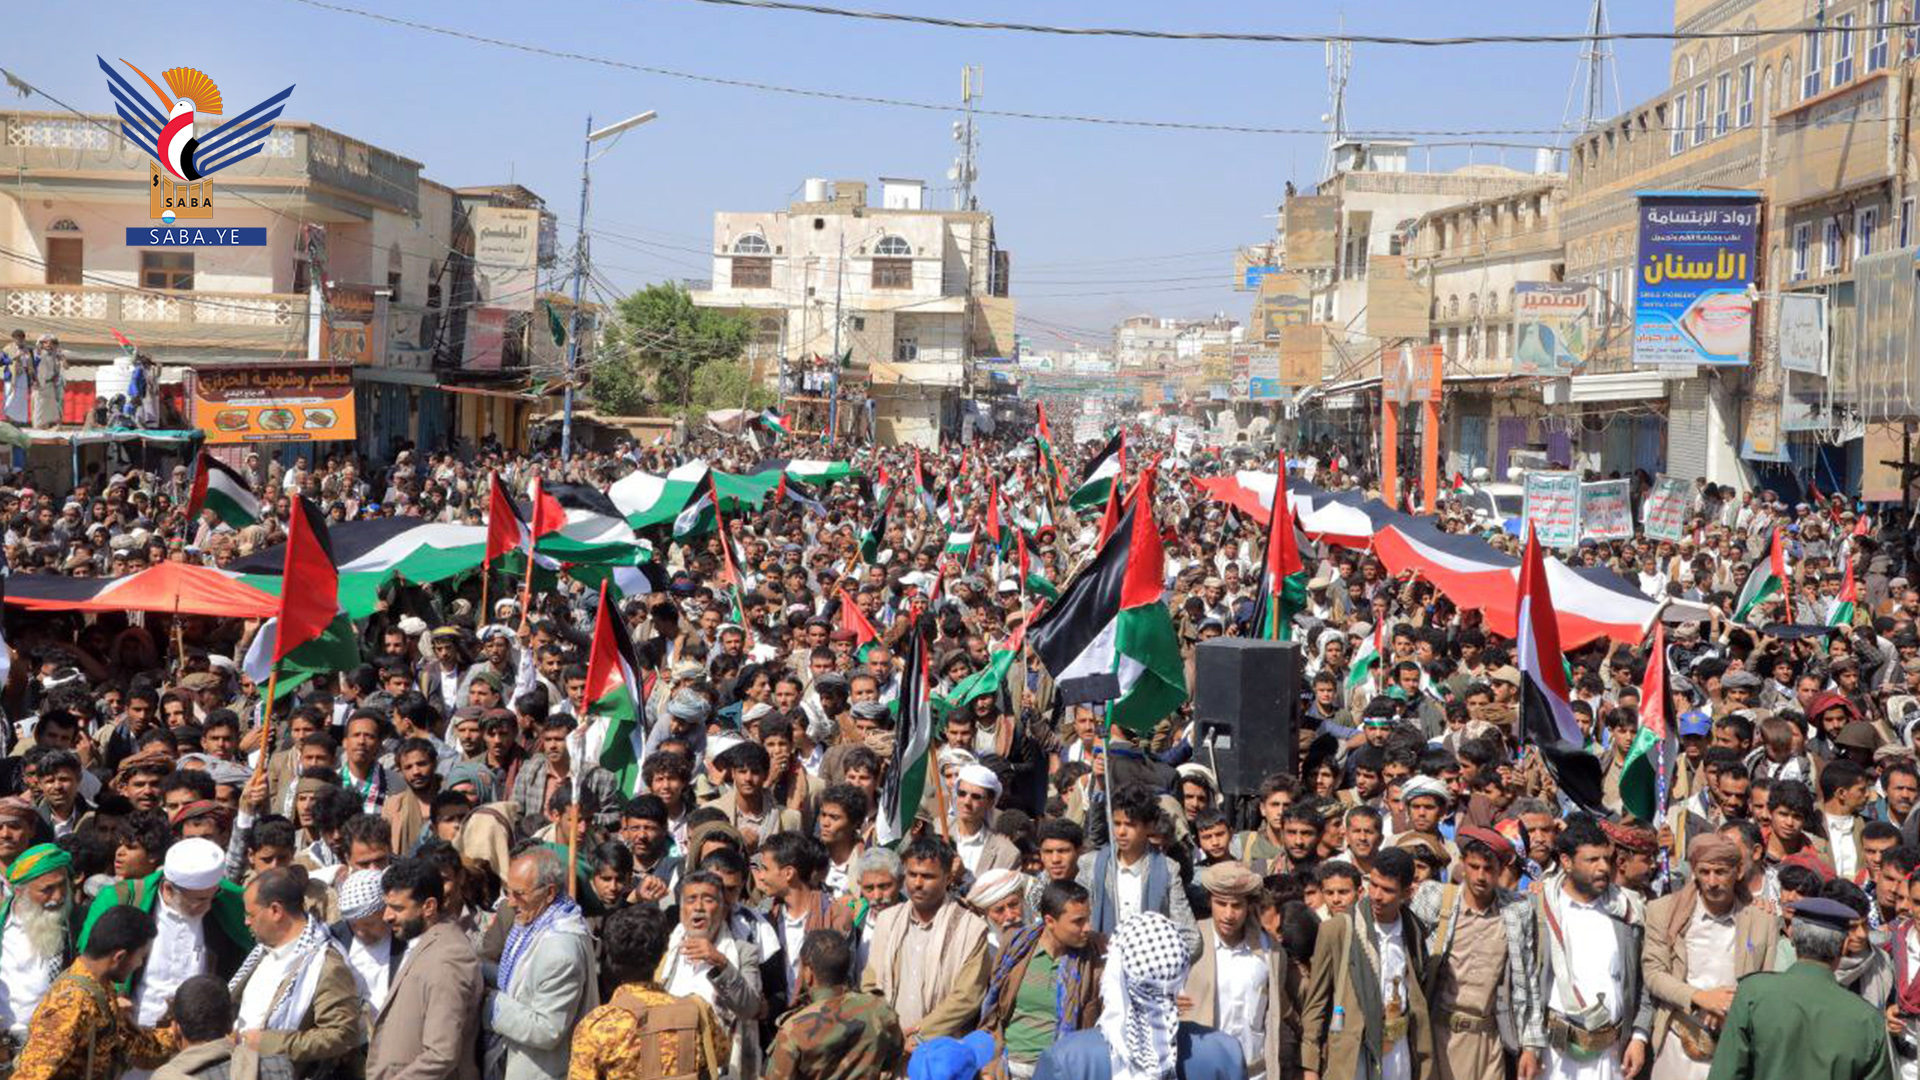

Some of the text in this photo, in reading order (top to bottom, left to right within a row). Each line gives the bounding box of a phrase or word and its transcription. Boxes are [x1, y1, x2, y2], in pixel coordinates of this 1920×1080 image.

[1722, 210, 1752, 226] رواد
[1644, 247, 1747, 284] الأسنان
[1523, 291, 1587, 310] المتميز
[309, 368, 350, 392] مطعم
